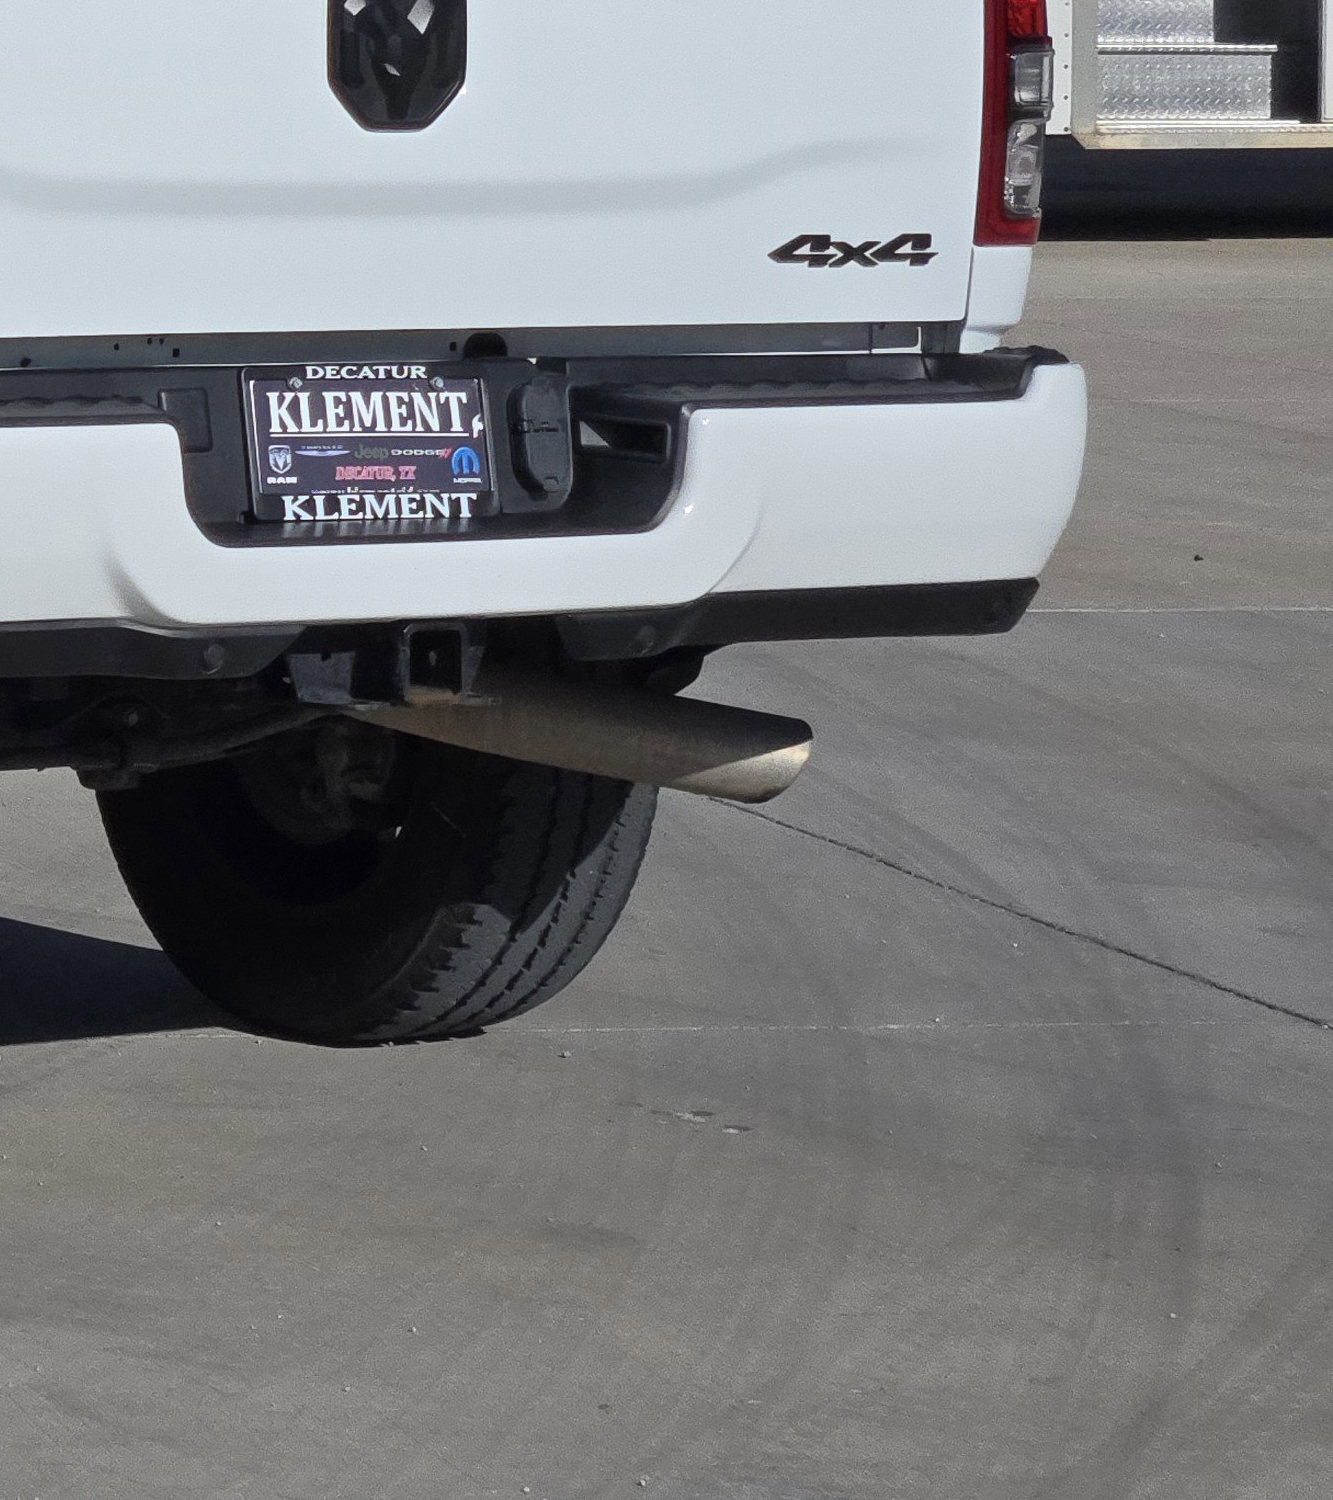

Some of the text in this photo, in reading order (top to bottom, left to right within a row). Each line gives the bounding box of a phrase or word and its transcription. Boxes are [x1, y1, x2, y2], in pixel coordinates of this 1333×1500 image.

[305, 365, 428, 380] DECATUR
[266, 390, 468, 433] KLEMENT
[354, 444, 389, 460] Jeep
[281, 493, 477, 521] KLEMENT
